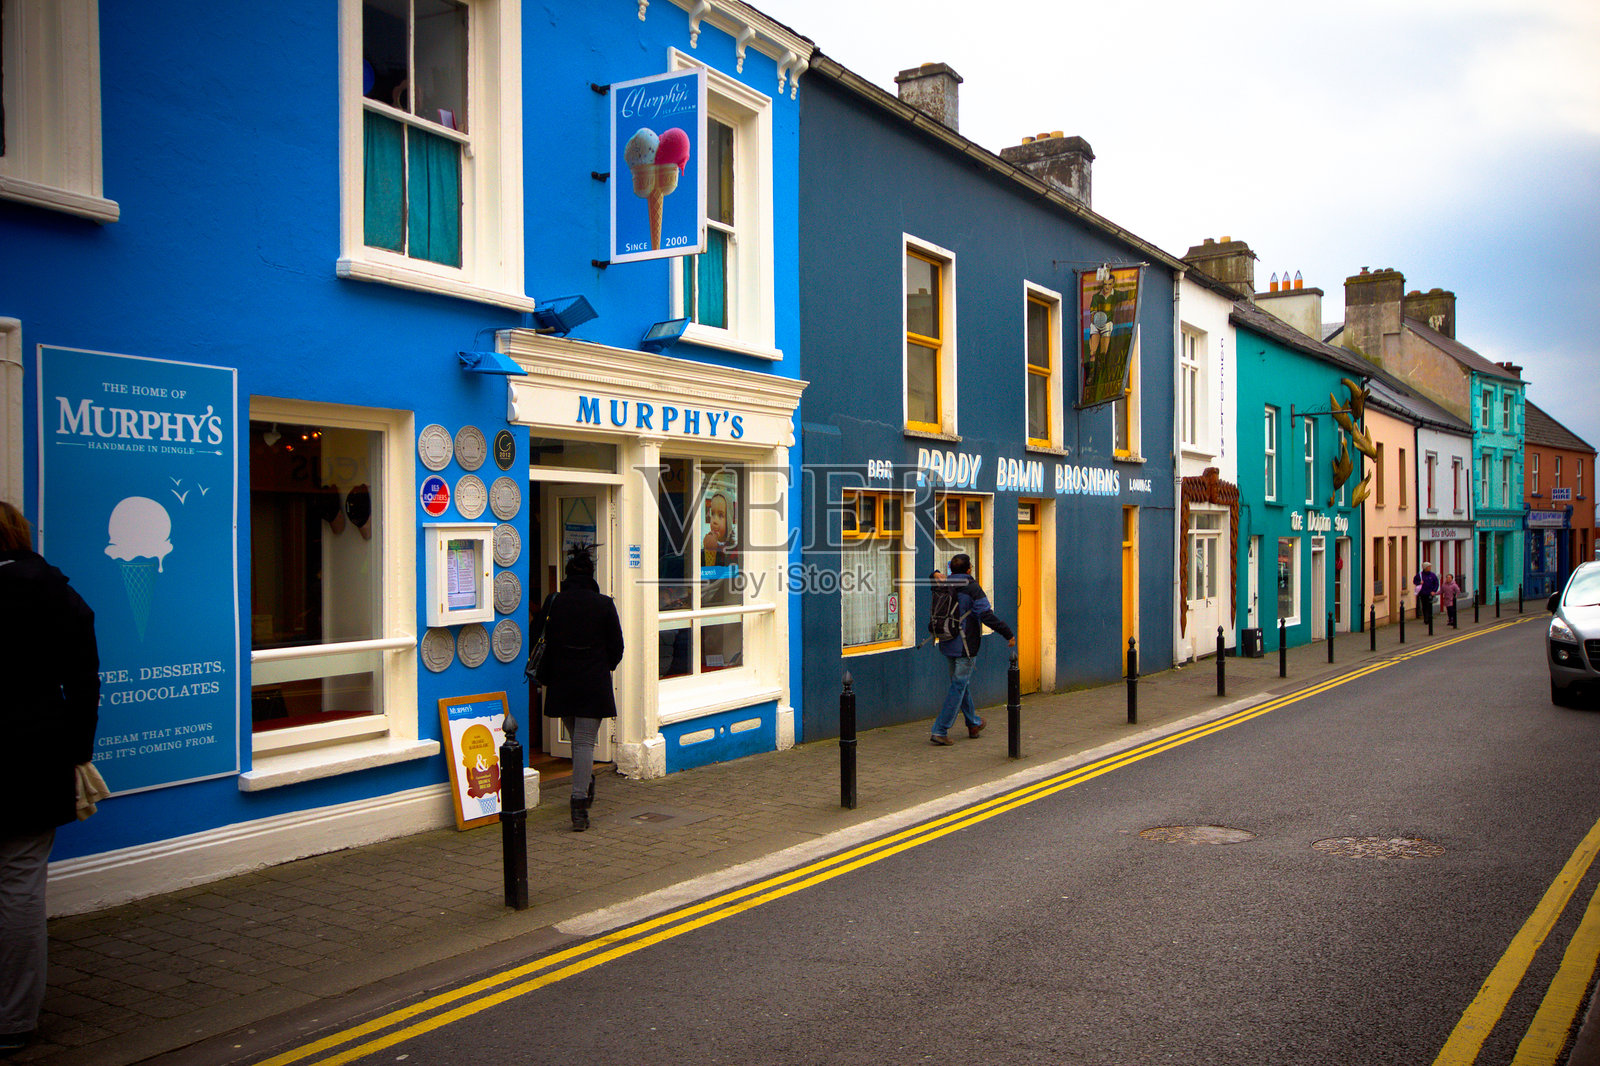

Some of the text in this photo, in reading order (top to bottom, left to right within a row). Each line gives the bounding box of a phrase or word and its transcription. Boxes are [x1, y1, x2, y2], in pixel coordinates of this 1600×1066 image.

[665, 235, 688, 247] 2000
[102, 382, 187, 400] THE HOME OF
[55, 396, 223, 445] MURPHY'S
[575, 395, 744, 439] MURPHY'S
[87, 441, 196, 455] HANDMADE IN DINGLE
[867, 447, 1153, 496] BAR PADDY BAWN BROSNANS LOUNGE
[431, 484, 440, 492] LES
[97, 661, 226, 684] FEE, DESSERTS,
[110, 682, 220, 706] CHOCOLATES
[98, 722, 213, 747] CREAM THAT KNOWS
[91, 735, 218, 762] ERE IT'S COMING FROM.
